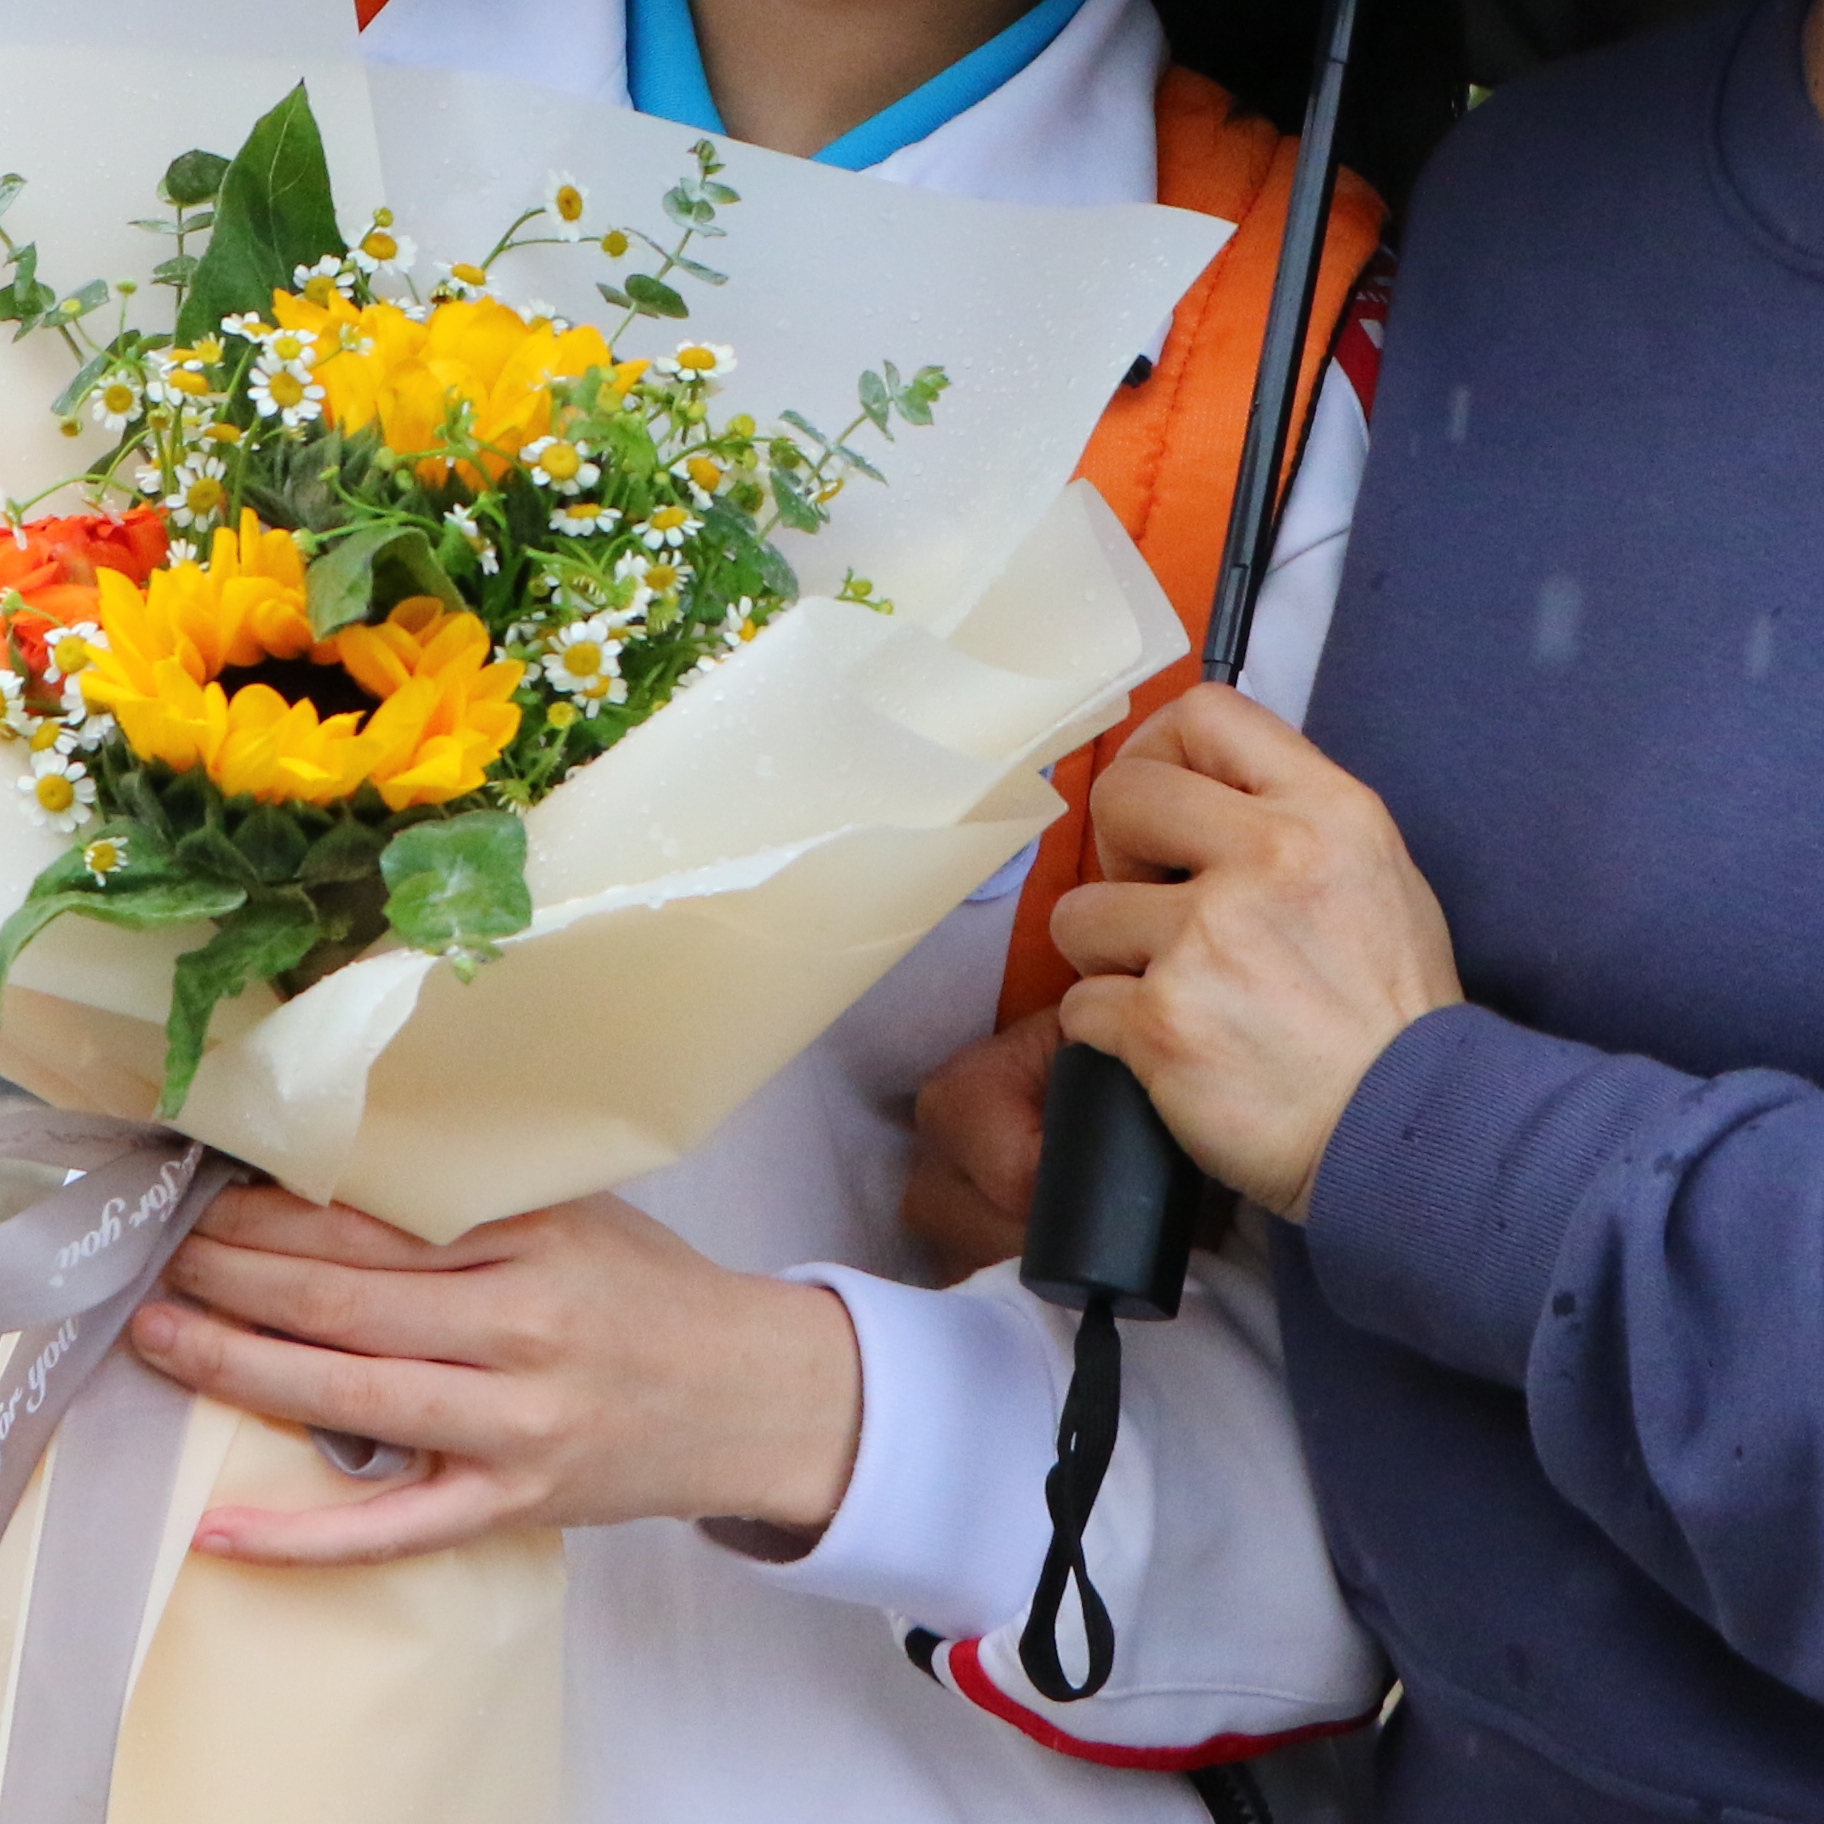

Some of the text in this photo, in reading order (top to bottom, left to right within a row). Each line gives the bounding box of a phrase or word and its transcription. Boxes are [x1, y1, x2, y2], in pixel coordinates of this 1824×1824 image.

[56, 1161, 180, 1269] for you
[26, 1316, 77, 1414] you
